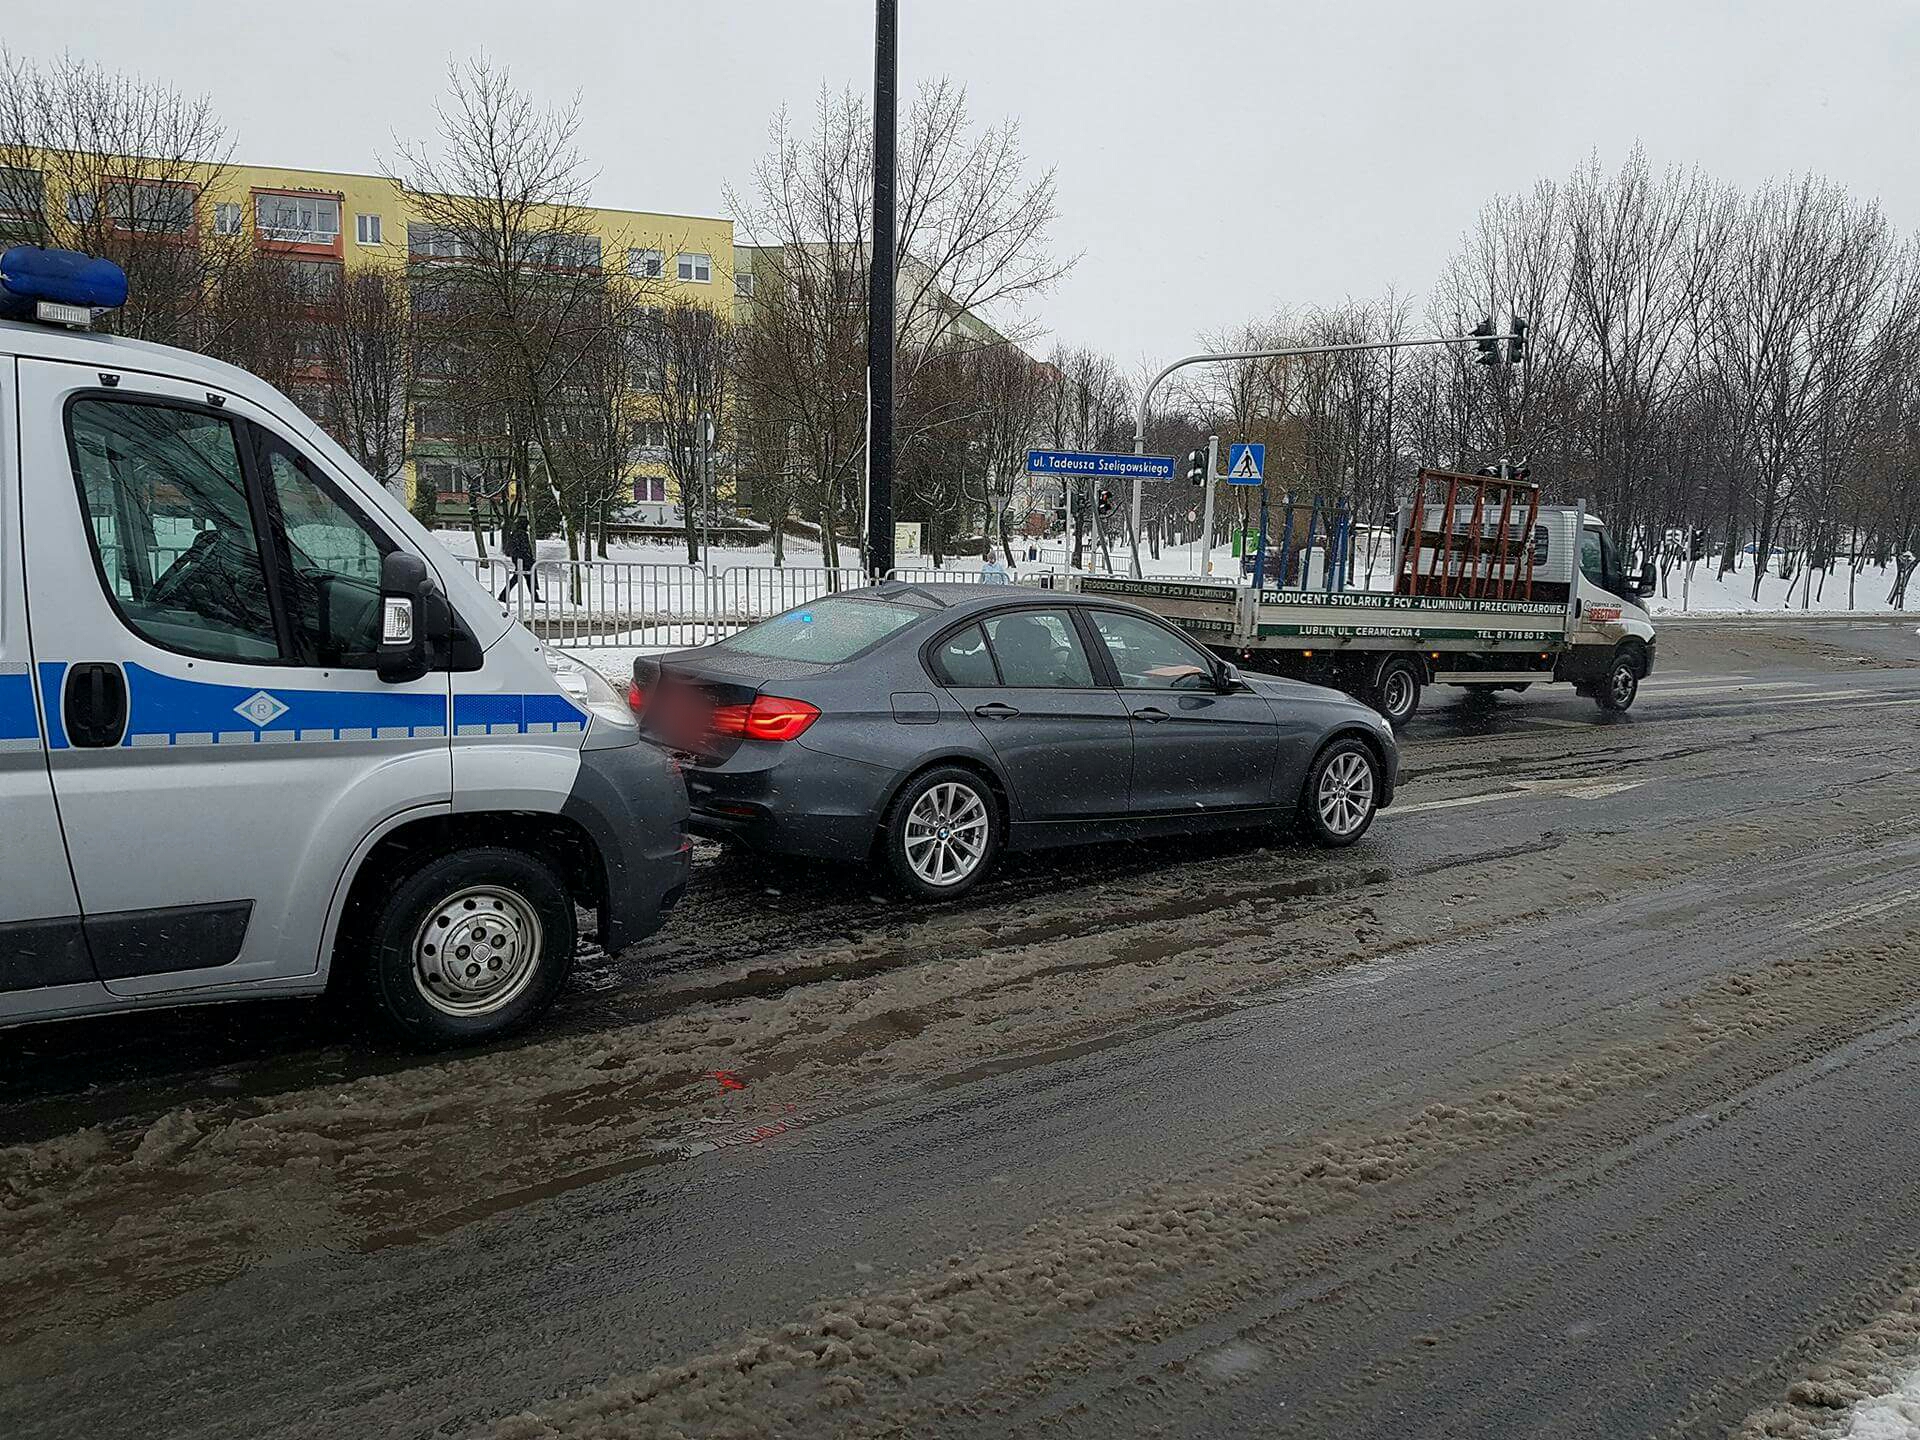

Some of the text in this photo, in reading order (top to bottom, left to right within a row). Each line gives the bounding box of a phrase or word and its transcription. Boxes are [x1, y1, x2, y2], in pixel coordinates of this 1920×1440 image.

[1033, 455, 1169, 476] ul. Tadeusza Szeligowskiego
[1083, 580, 1123, 592] PRODUCENT
[1124, 583, 1160, 594] STOLARKI
[1168, 586, 1183, 595] PCV
[1189, 586, 1234, 599] ALUMINIUM
[1262, 592, 1328, 605] PRODUCENT
[1330, 594, 1381, 607] STOLARKI
[1384, 597, 1391, 607] Z
[1393, 597, 1413, 608] PCV
[1420, 598, 1471, 610] ALUMINIUM
[1299, 626, 1420, 637] LUBLIN UL. CERAMICZNA 4
[1477, 630, 1545, 640] TEL. 81 718 80 12
[257, 703, 266, 714] R
